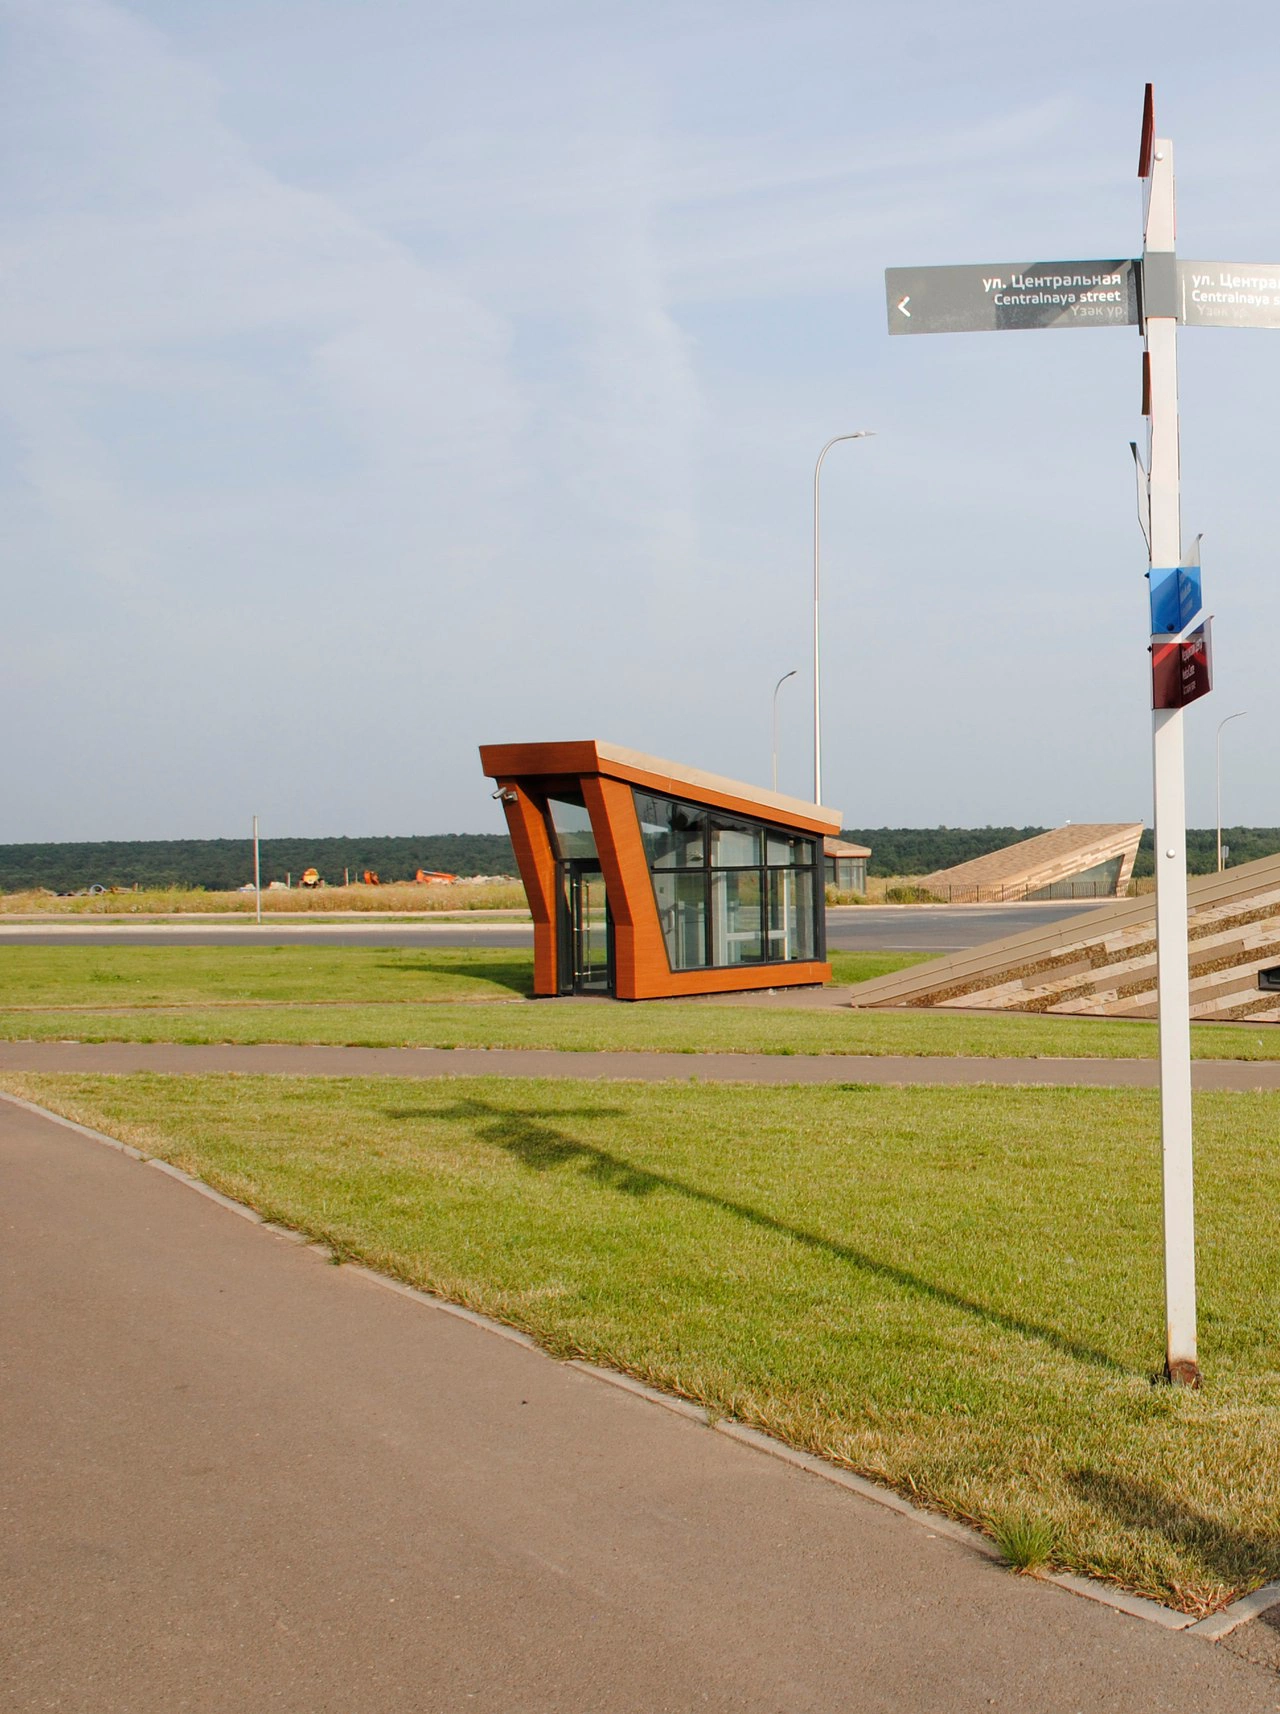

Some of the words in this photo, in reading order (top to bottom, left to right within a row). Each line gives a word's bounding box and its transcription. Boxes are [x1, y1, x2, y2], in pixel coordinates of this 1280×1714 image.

[983, 277, 1007, 292] ул.
[1012, 274, 1121, 290] Центральная
[1192, 273, 1215, 288] ул.
[994, 292, 1076, 306] Centralnaya
[1080, 290, 1121, 303] street
[1192, 290, 1270, 306] Centralnaya
